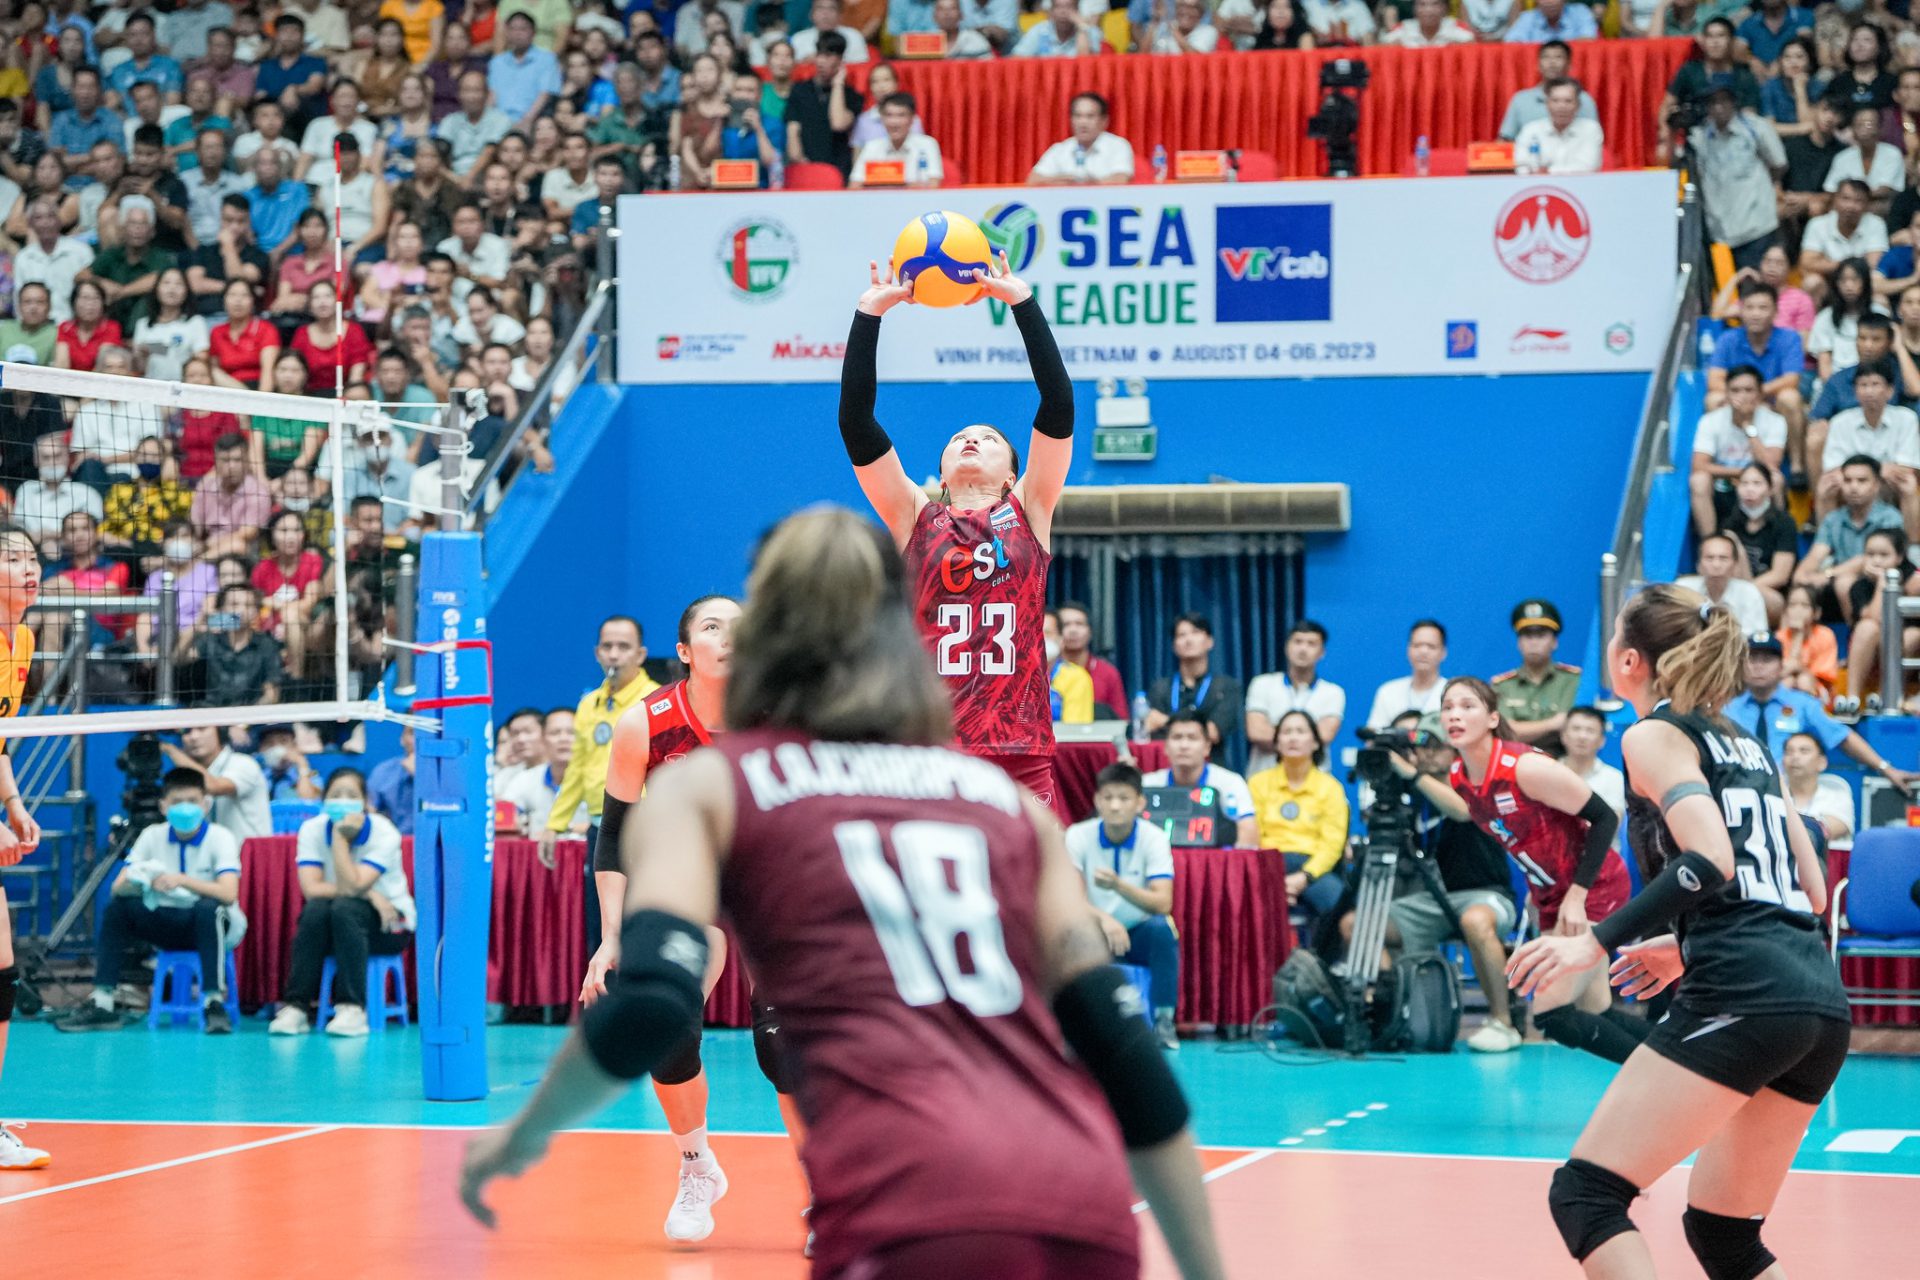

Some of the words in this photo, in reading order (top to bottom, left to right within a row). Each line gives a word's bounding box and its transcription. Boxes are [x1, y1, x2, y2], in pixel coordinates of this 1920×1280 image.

[1060, 205, 1195, 268] SEA
[1220, 247, 1329, 280] VTVcab
[936, 346, 981, 364] VINH
[987, 346, 1027, 363] PHU
[1172, 344, 1247, 362] AUGUST
[941, 534, 1010, 593] est
[992, 572, 1010, 587] COLA
[443, 626, 460, 690] Snoh
[937, 603, 1016, 675] 23
[652, 700, 670, 713] PEA
[1721, 788, 1813, 913] 30
[833, 819, 1024, 1017] 18
